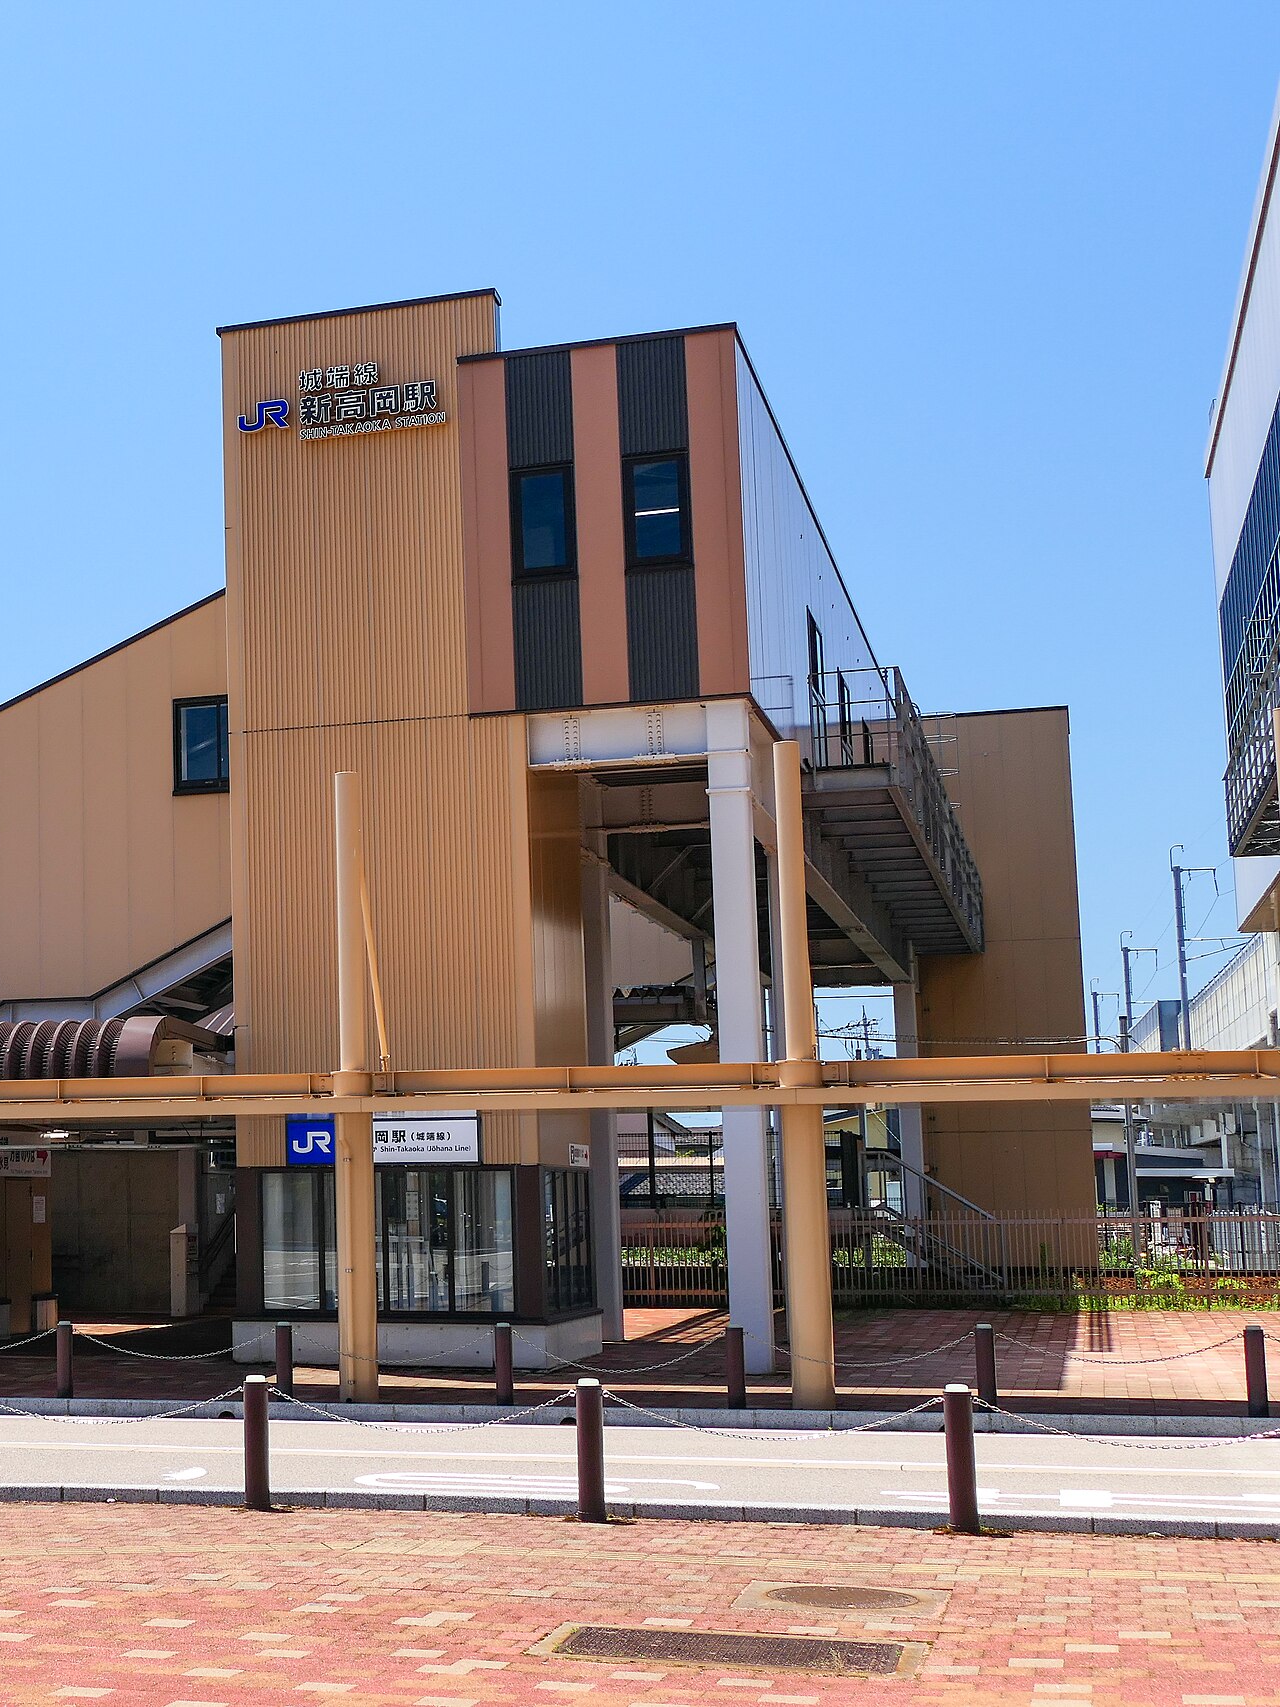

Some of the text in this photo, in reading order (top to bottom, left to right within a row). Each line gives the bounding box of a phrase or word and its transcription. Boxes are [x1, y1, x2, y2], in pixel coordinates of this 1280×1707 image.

[299, 361, 379, 392] 城端線
[237, 398, 290, 434] JR
[299, 379, 438, 425] 新高岡駅
[299, 411, 446, 440] SHIN-TAKAOKA STATION
[292, 1131, 331, 1154] JR
[380, 1145, 425, 1153] Shin-Takaoka
[454, 1144, 471, 1152] Line)
